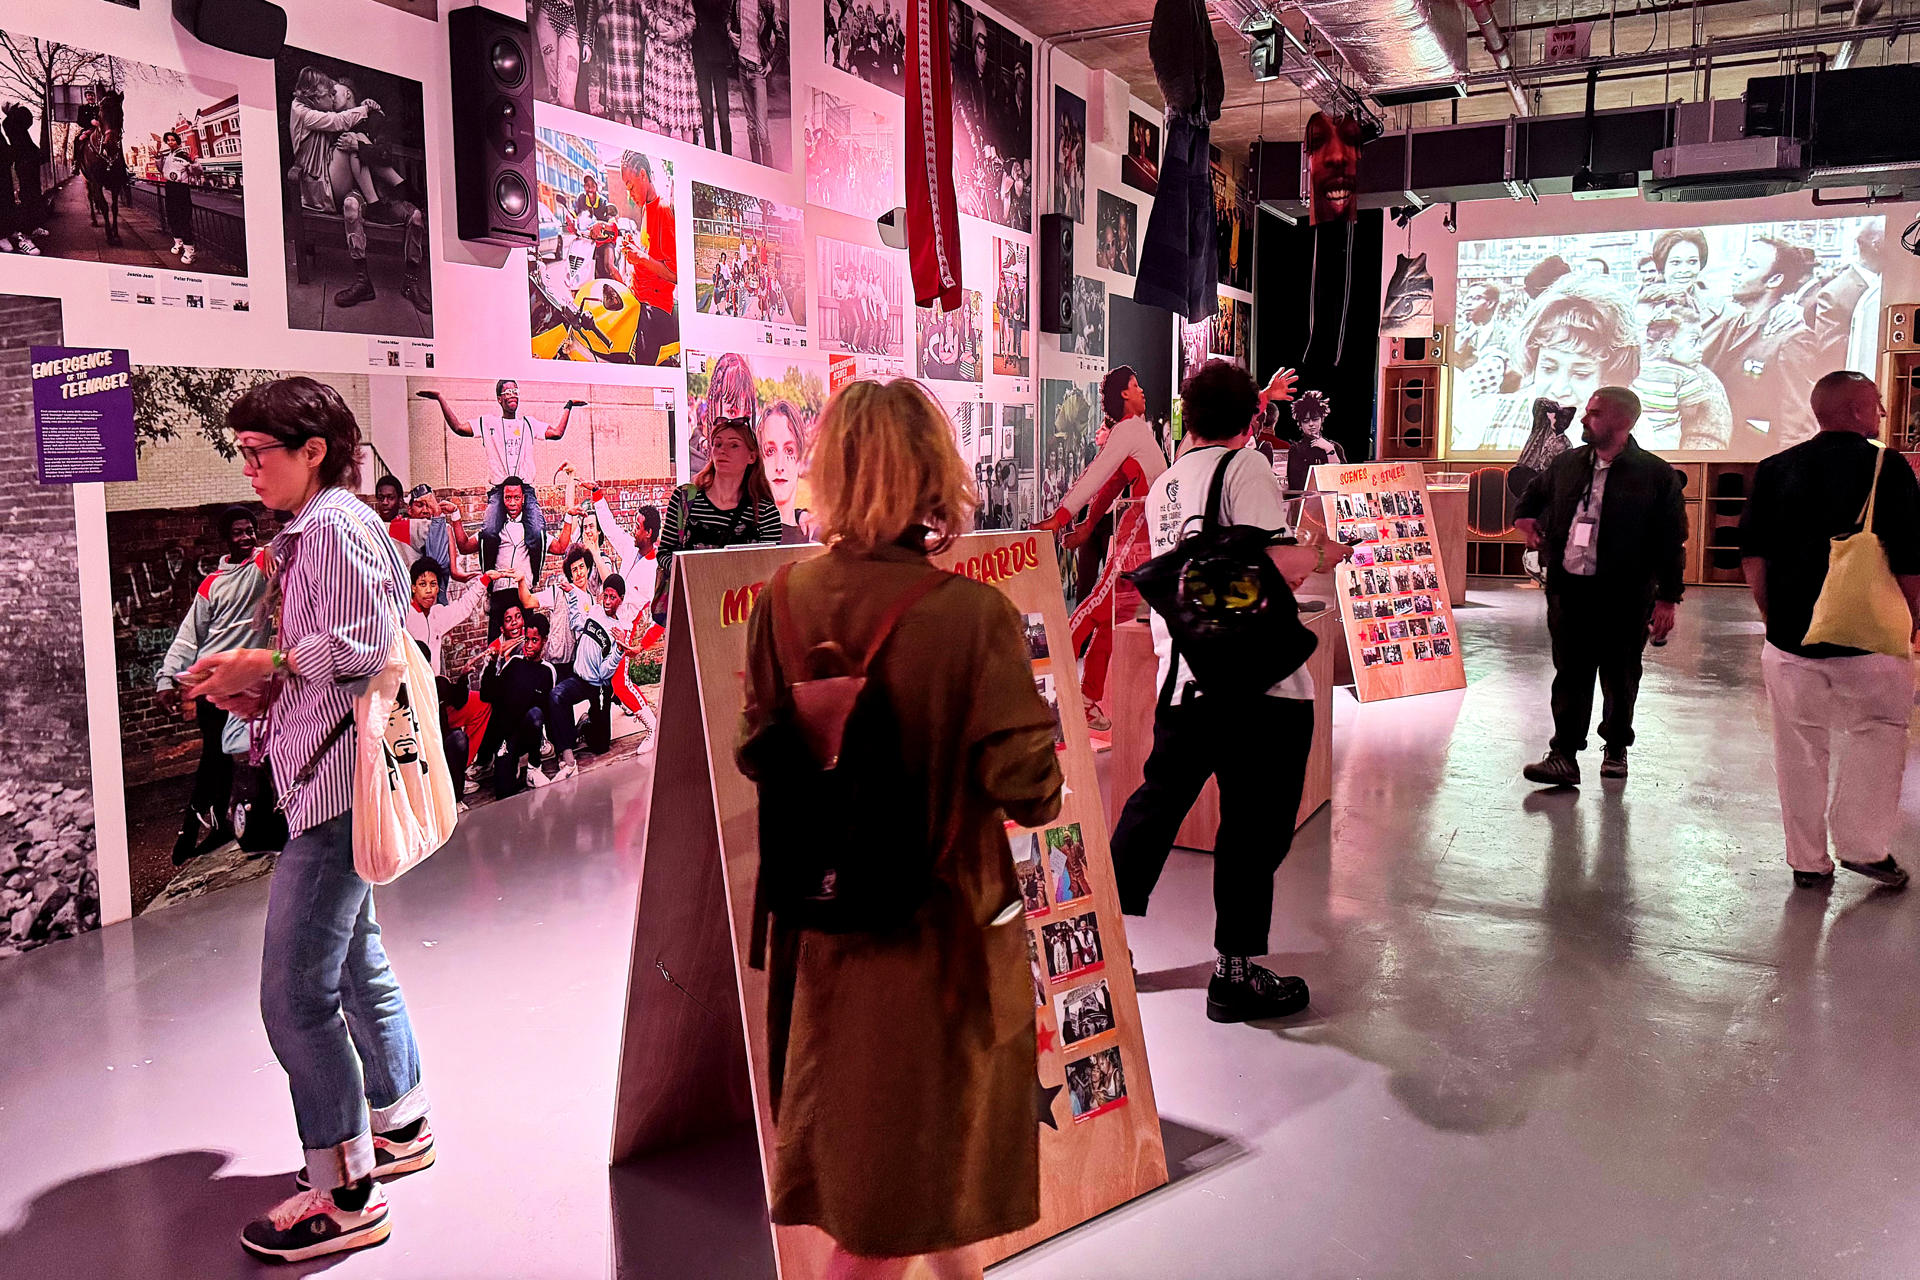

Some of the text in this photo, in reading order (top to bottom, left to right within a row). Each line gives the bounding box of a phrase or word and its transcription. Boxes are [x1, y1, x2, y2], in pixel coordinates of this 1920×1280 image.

[32, 350, 113, 379] EMERGENCE
[66, 371, 88, 382] OF THE
[60, 372, 129, 400] TEENAGER
[1340, 467, 1368, 485] SCENES
[1380, 464, 1406, 483] STYLES
